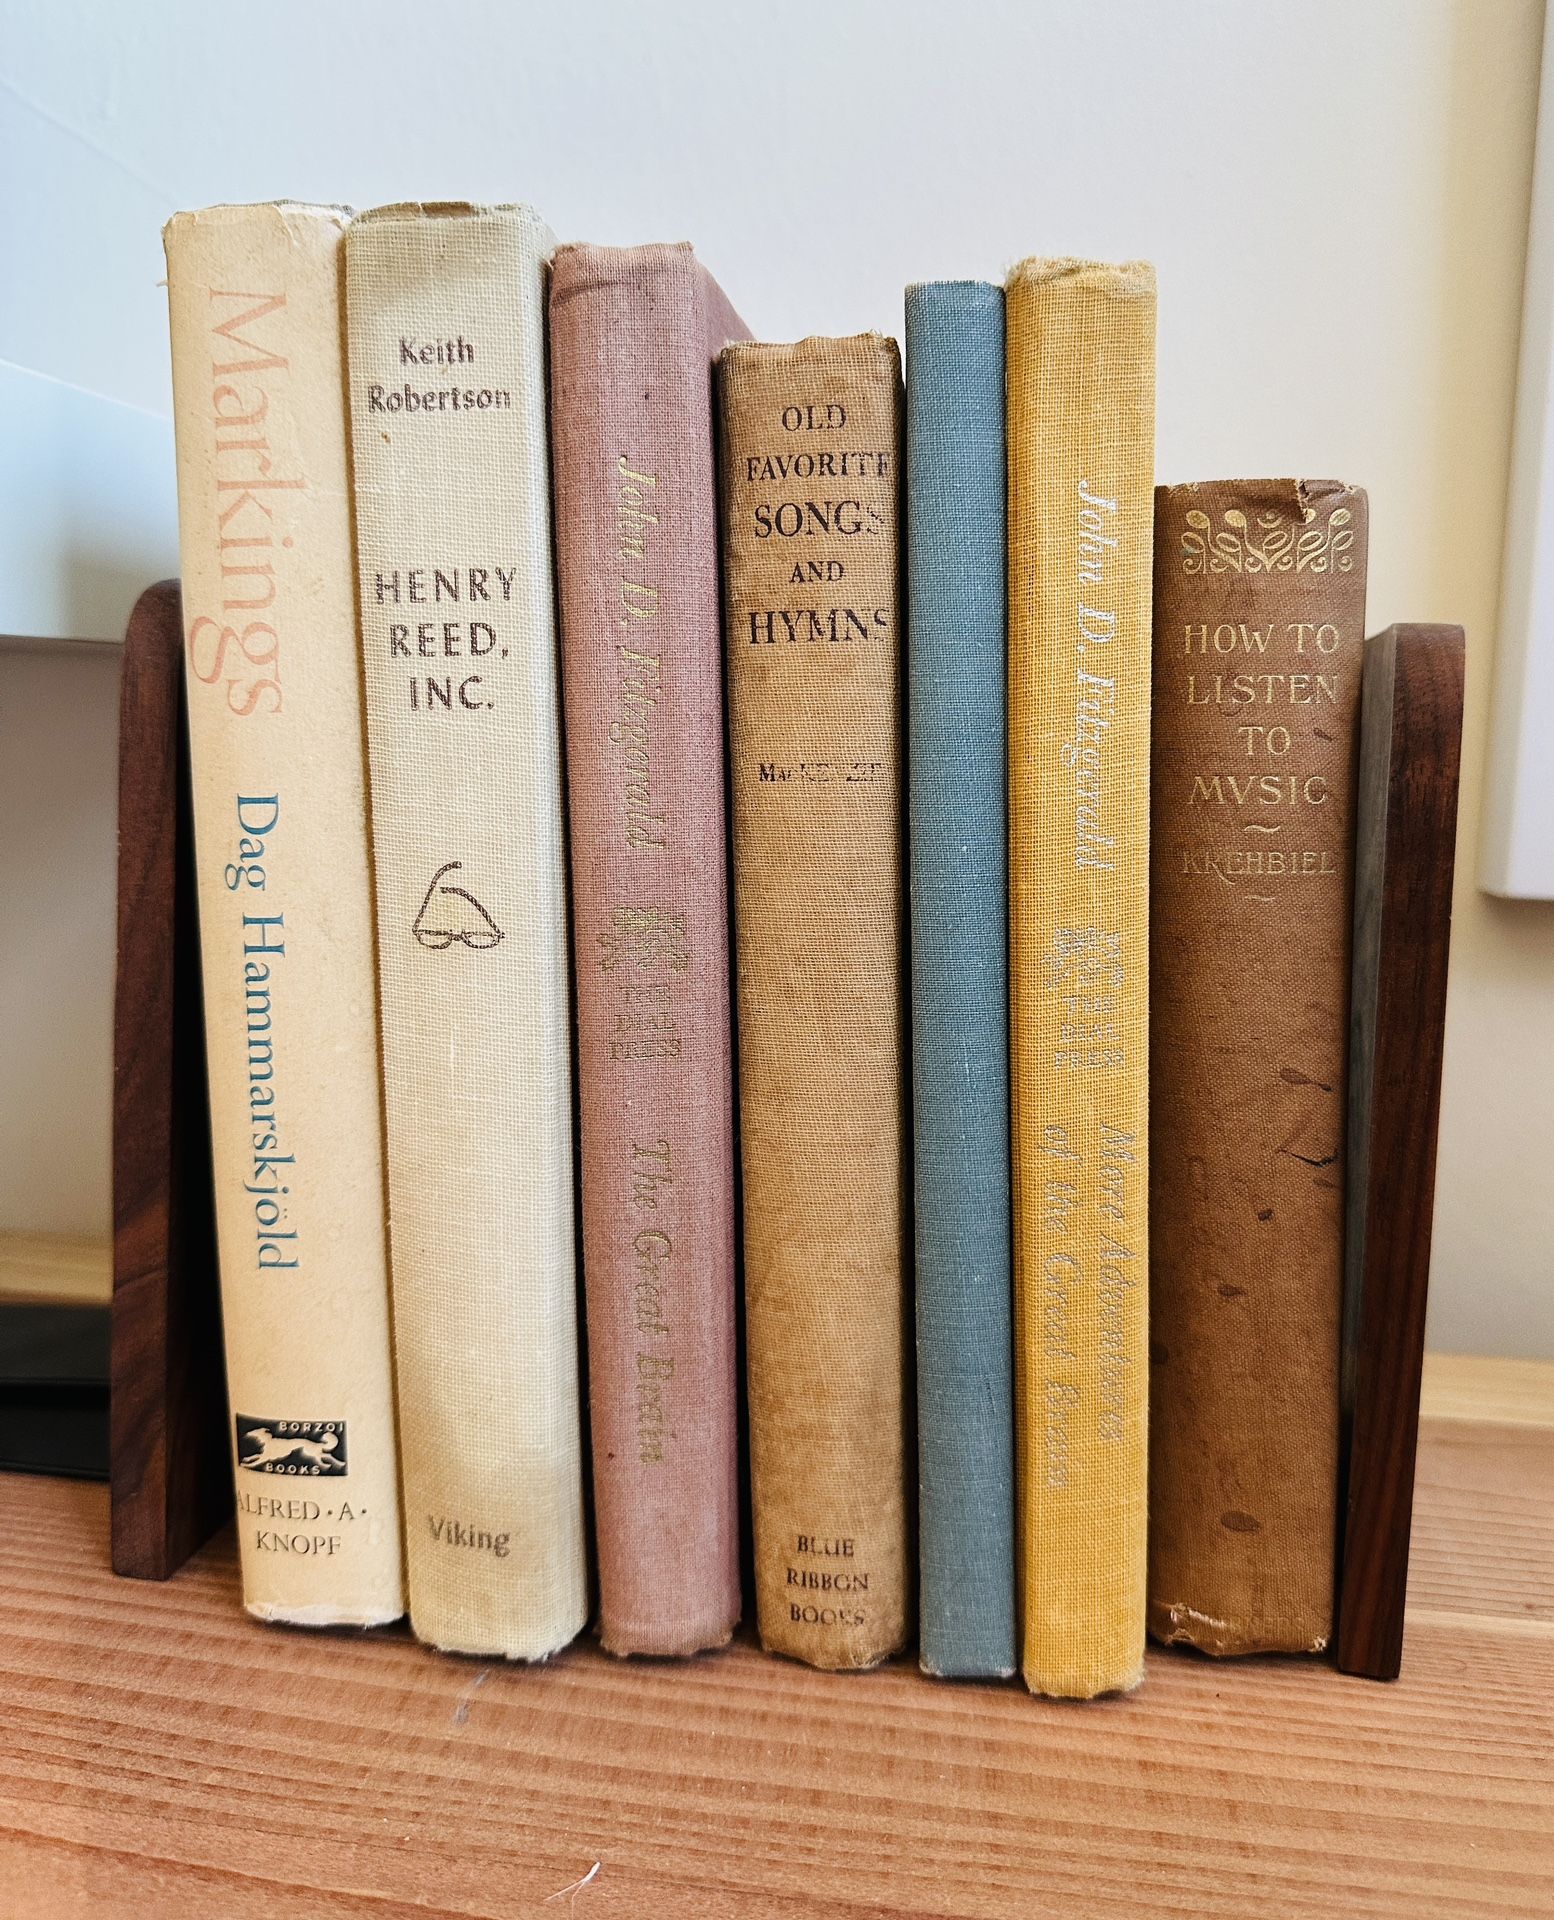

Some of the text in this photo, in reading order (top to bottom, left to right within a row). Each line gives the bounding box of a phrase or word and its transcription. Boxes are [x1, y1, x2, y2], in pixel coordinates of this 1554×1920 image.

[399, 336, 475, 366] Keith
[367, 384, 511, 414] Robertson
[782, 404, 847, 432] OLD
[746, 452, 891, 482] FAVORITE
[190, 287, 307, 718] Markings
[375, 567, 516, 605] HENRY
[790, 560, 846, 583] AND
[389, 622, 510, 660] REED,
[608, 456, 666, 850] John D. Fitzgerald
[1183, 623, 1341, 654] HOW TO
[1059, 480, 1119, 871] John D. Fitzgerald
[1187, 675, 1338, 706] LISTEN
[409, 676, 496, 712] INC.
[1237, 726, 1292, 756] TO
[1188, 775, 1327, 806] MVSIC
[1182, 851, 1337, 885] KREHBIEL
[225, 793, 301, 1270] Dag Hammarskjöld
[1037, 1124, 1083, 1166] of
[631, 1138, 673, 1211] The
[1098, 1121, 1139, 1221] More
[632, 1229, 674, 1337] Great
[278, 1421, 345, 1433] BORZOI
[265, 1463, 321, 1475] BOOKS
[256, 1529, 342, 1556] KNOPF
[428, 1513, 511, 1559] Viking
[797, 1535, 855, 1558] BLUE
[786, 1567, 870, 1592] RIBBON
[790, 1603, 866, 1626] BOOKS
